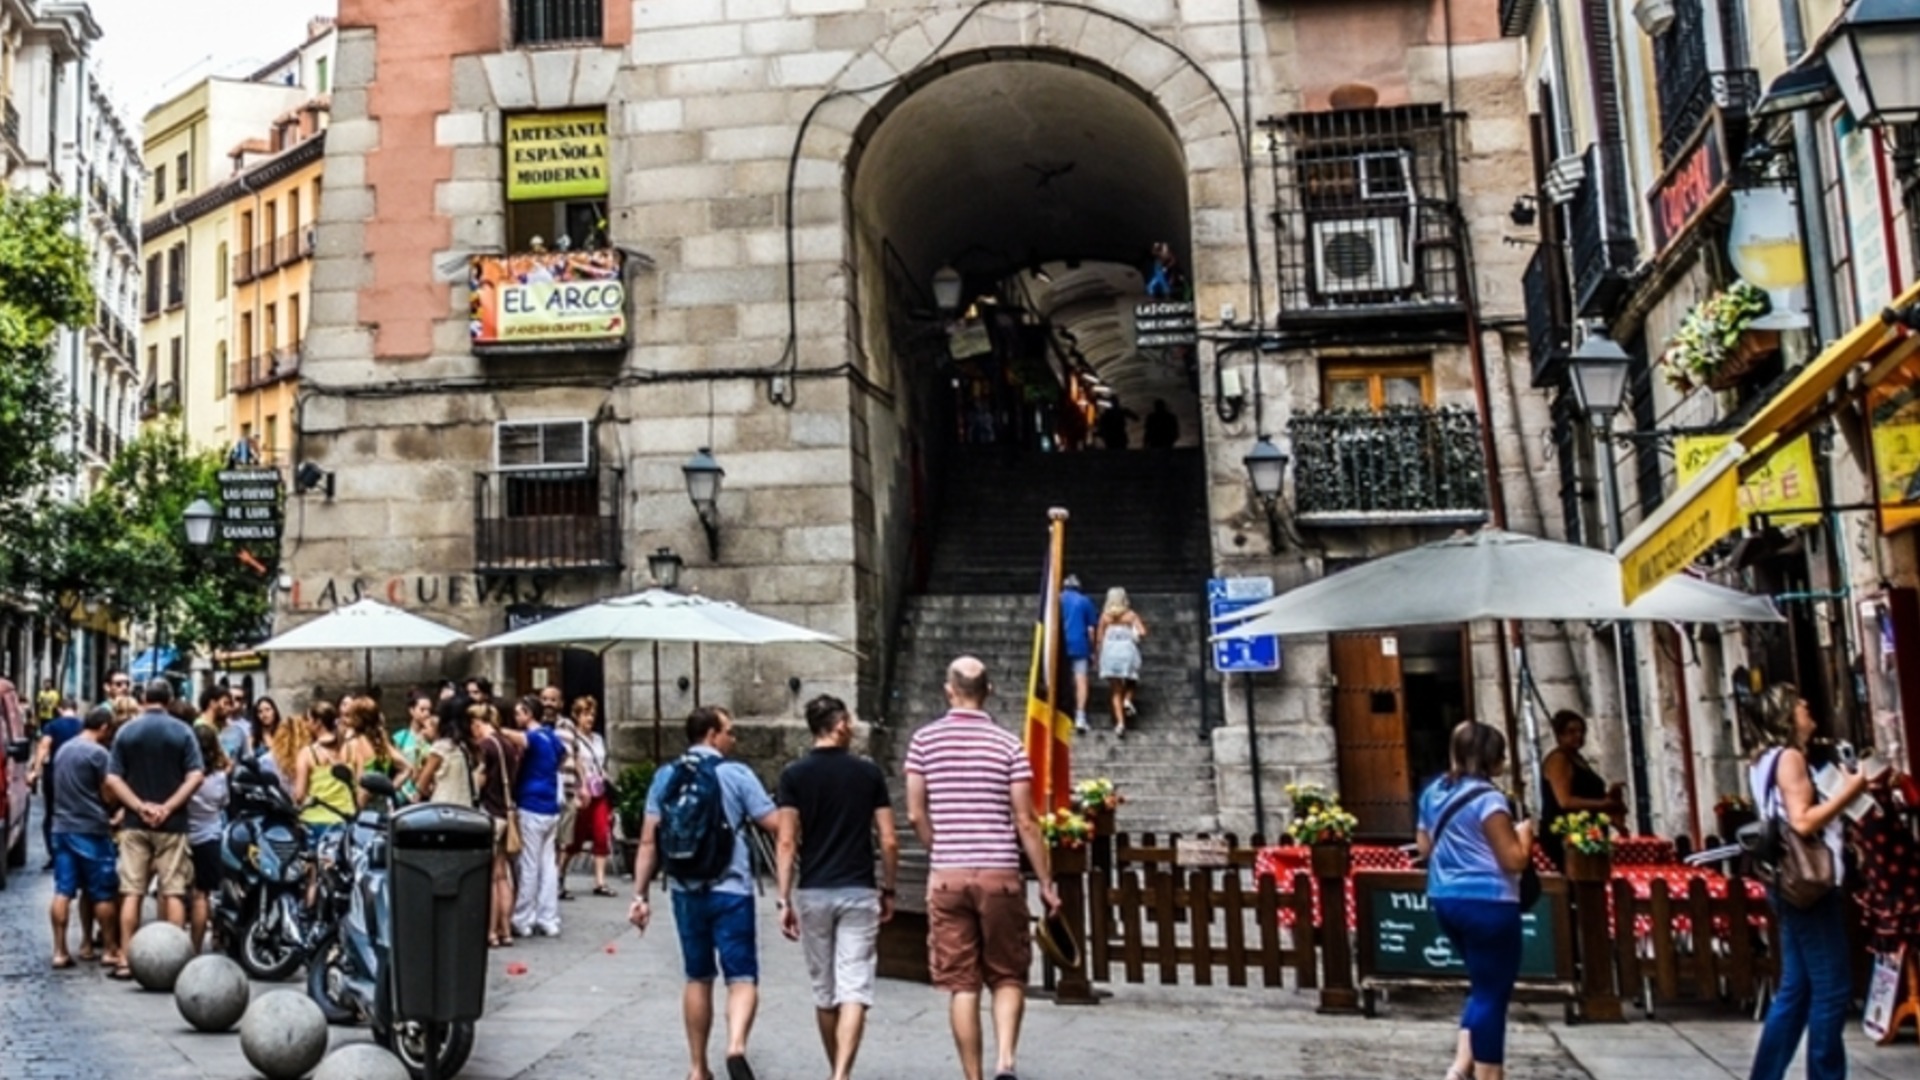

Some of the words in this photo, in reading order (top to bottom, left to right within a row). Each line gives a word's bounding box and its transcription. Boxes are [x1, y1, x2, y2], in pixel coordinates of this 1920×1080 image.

[512, 123, 607, 141] ARTESANIA
[515, 142, 603, 163] ESPAÑOLA
[517, 166, 600, 184] MODERNA
[504, 288, 535, 313] EL
[545, 284, 621, 310] ARCO
[552, 323, 592, 334] CRAFTS
[222, 487, 241, 500] LAS
[1736, 463, 1802, 508] AFÉ
[227, 506, 242, 519] DE
[245, 506, 271, 519] LUIS
[222, 526, 277, 539] CANDELAS
[290, 578, 367, 610] LAS
[386, 575, 545, 606] CUEVAS
